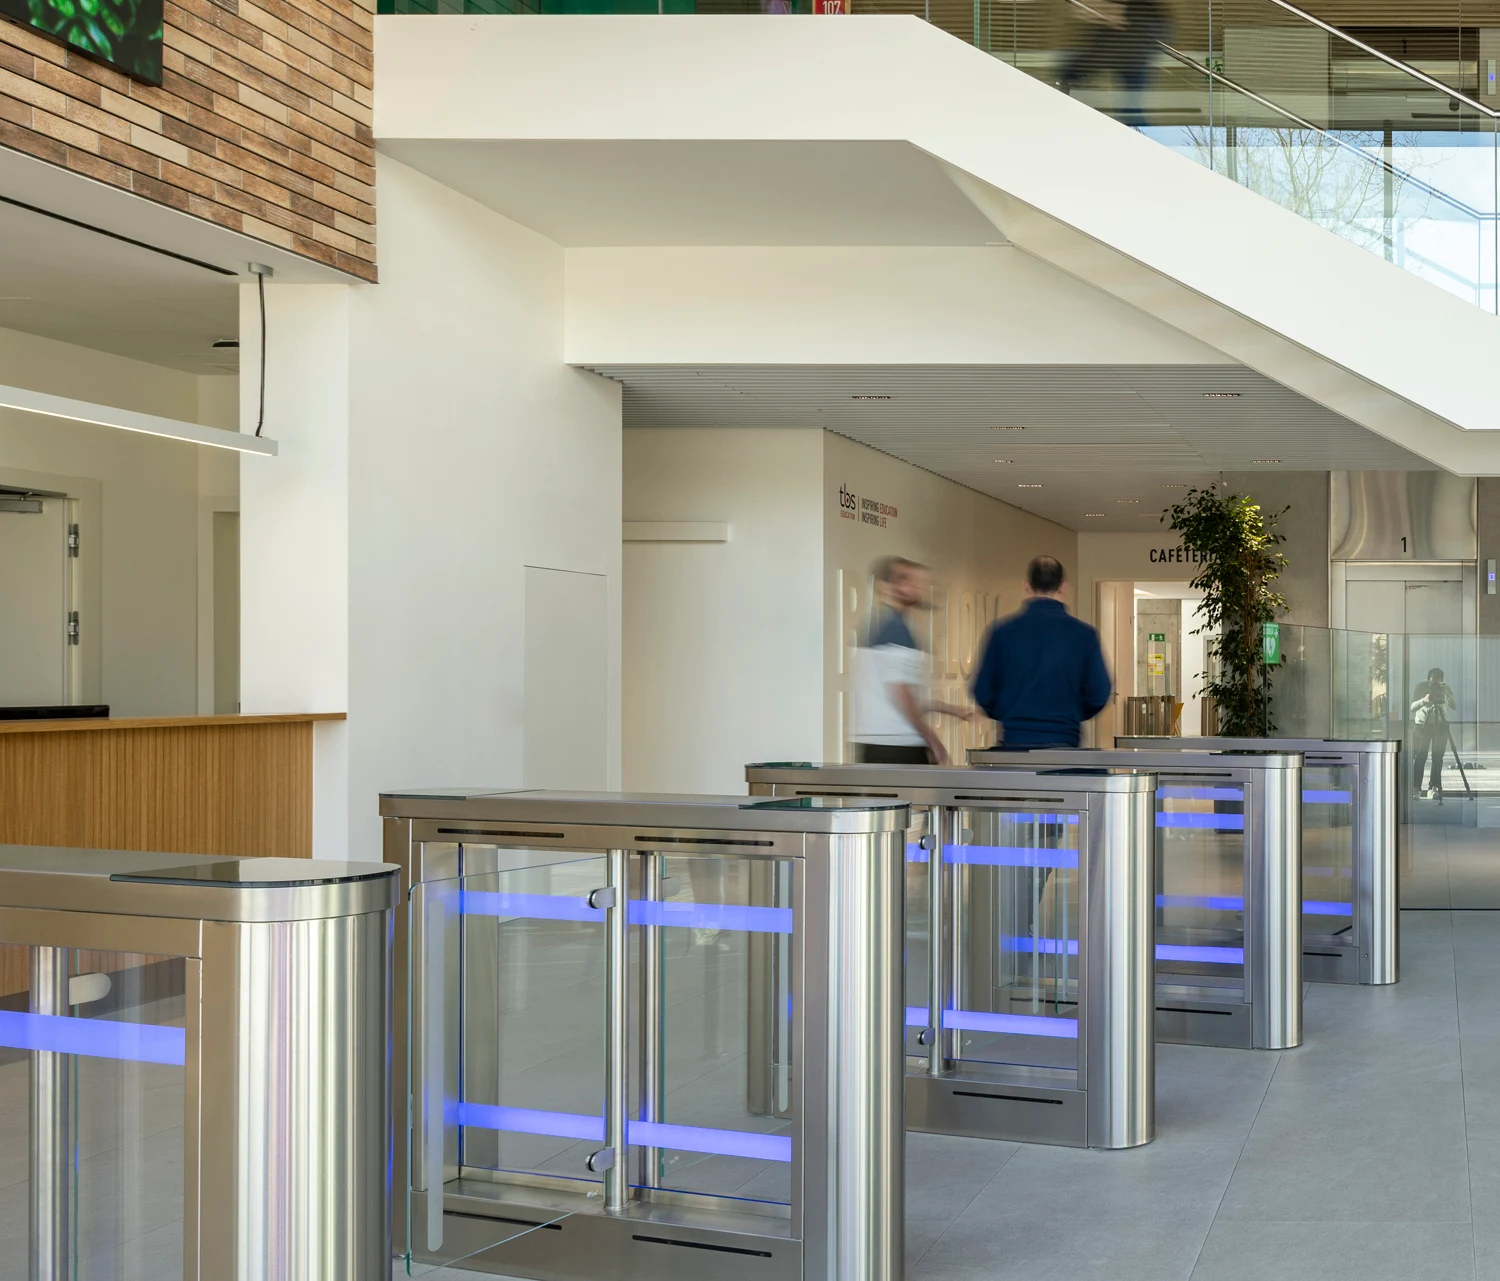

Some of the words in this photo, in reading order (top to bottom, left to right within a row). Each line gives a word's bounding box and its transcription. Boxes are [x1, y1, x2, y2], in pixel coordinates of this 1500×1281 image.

[823, 0, 841, 15] 107
[839, 482, 856, 510] tbs
[862, 497, 879, 513] INSPIRING
[880, 502, 898, 518] EDUCATION
[862, 511, 879, 526] INSPIRING
[1400, 536, 1406, 553] 1
